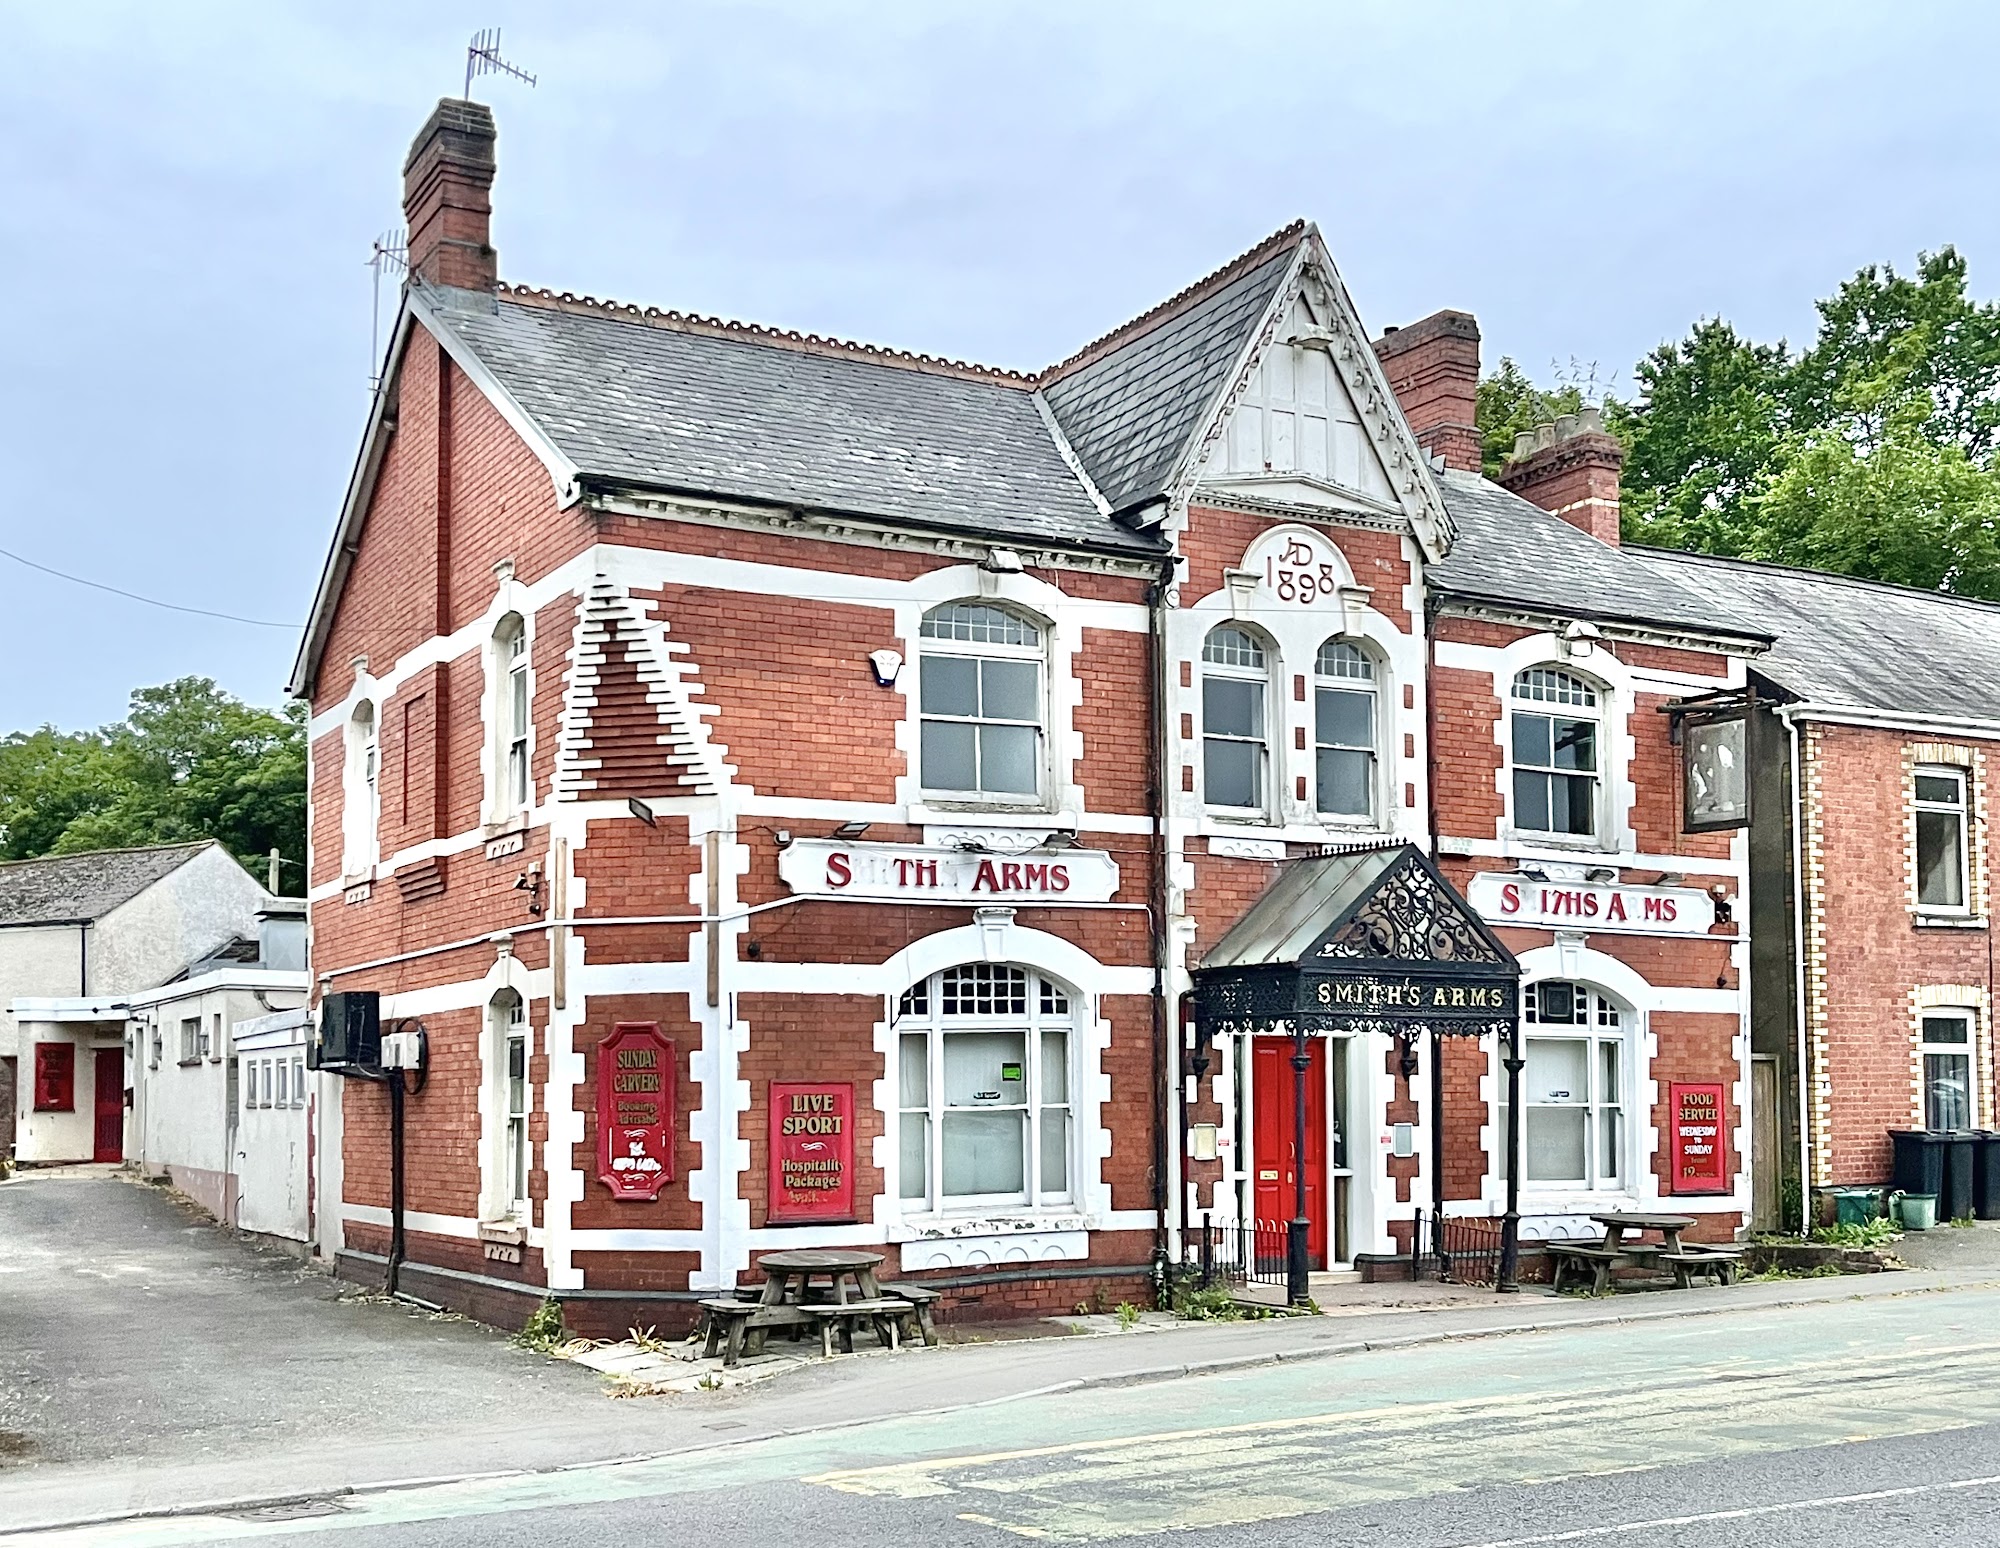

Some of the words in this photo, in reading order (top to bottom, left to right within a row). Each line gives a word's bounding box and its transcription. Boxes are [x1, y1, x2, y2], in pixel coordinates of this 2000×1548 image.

[1267, 556, 1335, 604] 1898
[972, 859, 1070, 892] ARMS
[1501, 884, 1599, 918] SITHS
[1606, 893, 1677, 923] AMS
[1318, 977, 1421, 1007] SMITH'S
[1433, 987, 1503, 1008] ARMS
[618, 1050, 657, 1068] SUNDAY
[614, 1073, 660, 1092] CARVERY
[792, 1094, 834, 1113] LIVE
[1683, 1093, 1714, 1105] FOOD
[1679, 1108, 1718, 1121] SERVED
[783, 1116, 842, 1135] SPORT
[1679, 1126, 1717, 1137] WEDNESDAY
[1684, 1145, 1713, 1155] SUNDAY
[782, 1159, 844, 1174] Hospitality
[785, 1175, 842, 1189] Packages
